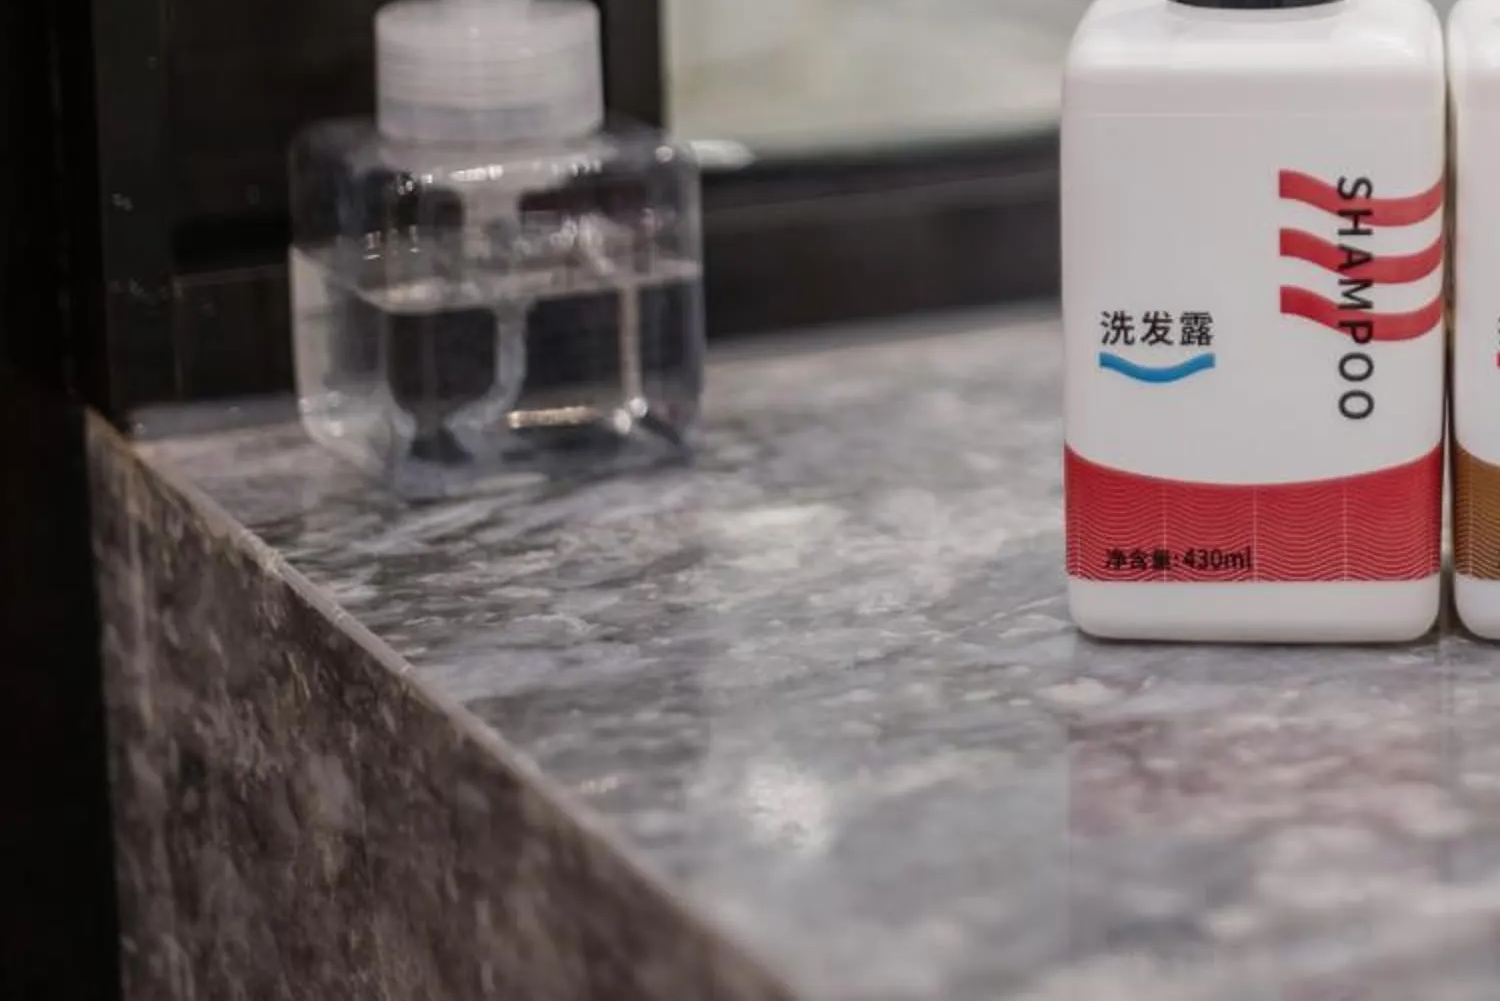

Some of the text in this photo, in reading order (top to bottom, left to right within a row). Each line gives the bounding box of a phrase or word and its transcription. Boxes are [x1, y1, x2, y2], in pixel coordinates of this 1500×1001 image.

[1100, 310, 1215, 347] 洗发露
[1337, 176, 1375, 420] SHAMPOO
